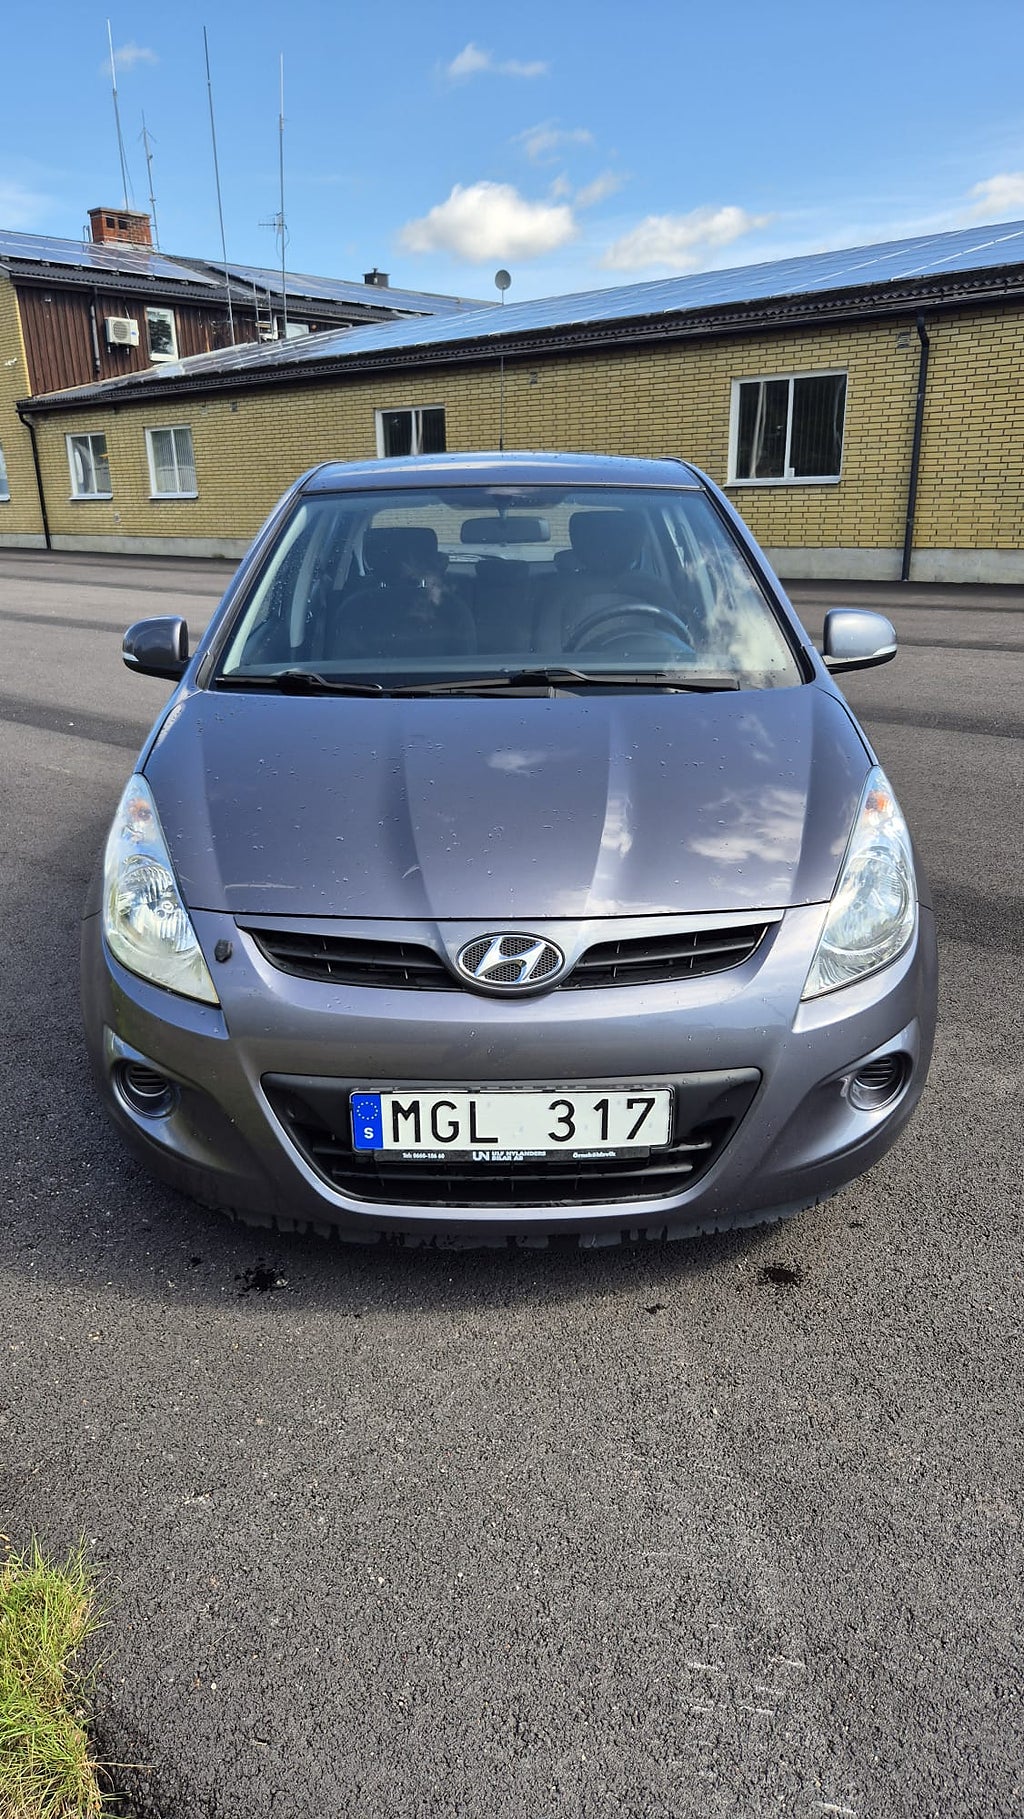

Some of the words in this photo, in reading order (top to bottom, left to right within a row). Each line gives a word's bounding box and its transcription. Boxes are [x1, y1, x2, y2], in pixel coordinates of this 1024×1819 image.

[391, 1100, 499, 1144] MGL
[548, 1098, 656, 1142] 317
[364, 1127, 374, 1139] S
[472, 1151, 490, 1161] UN
